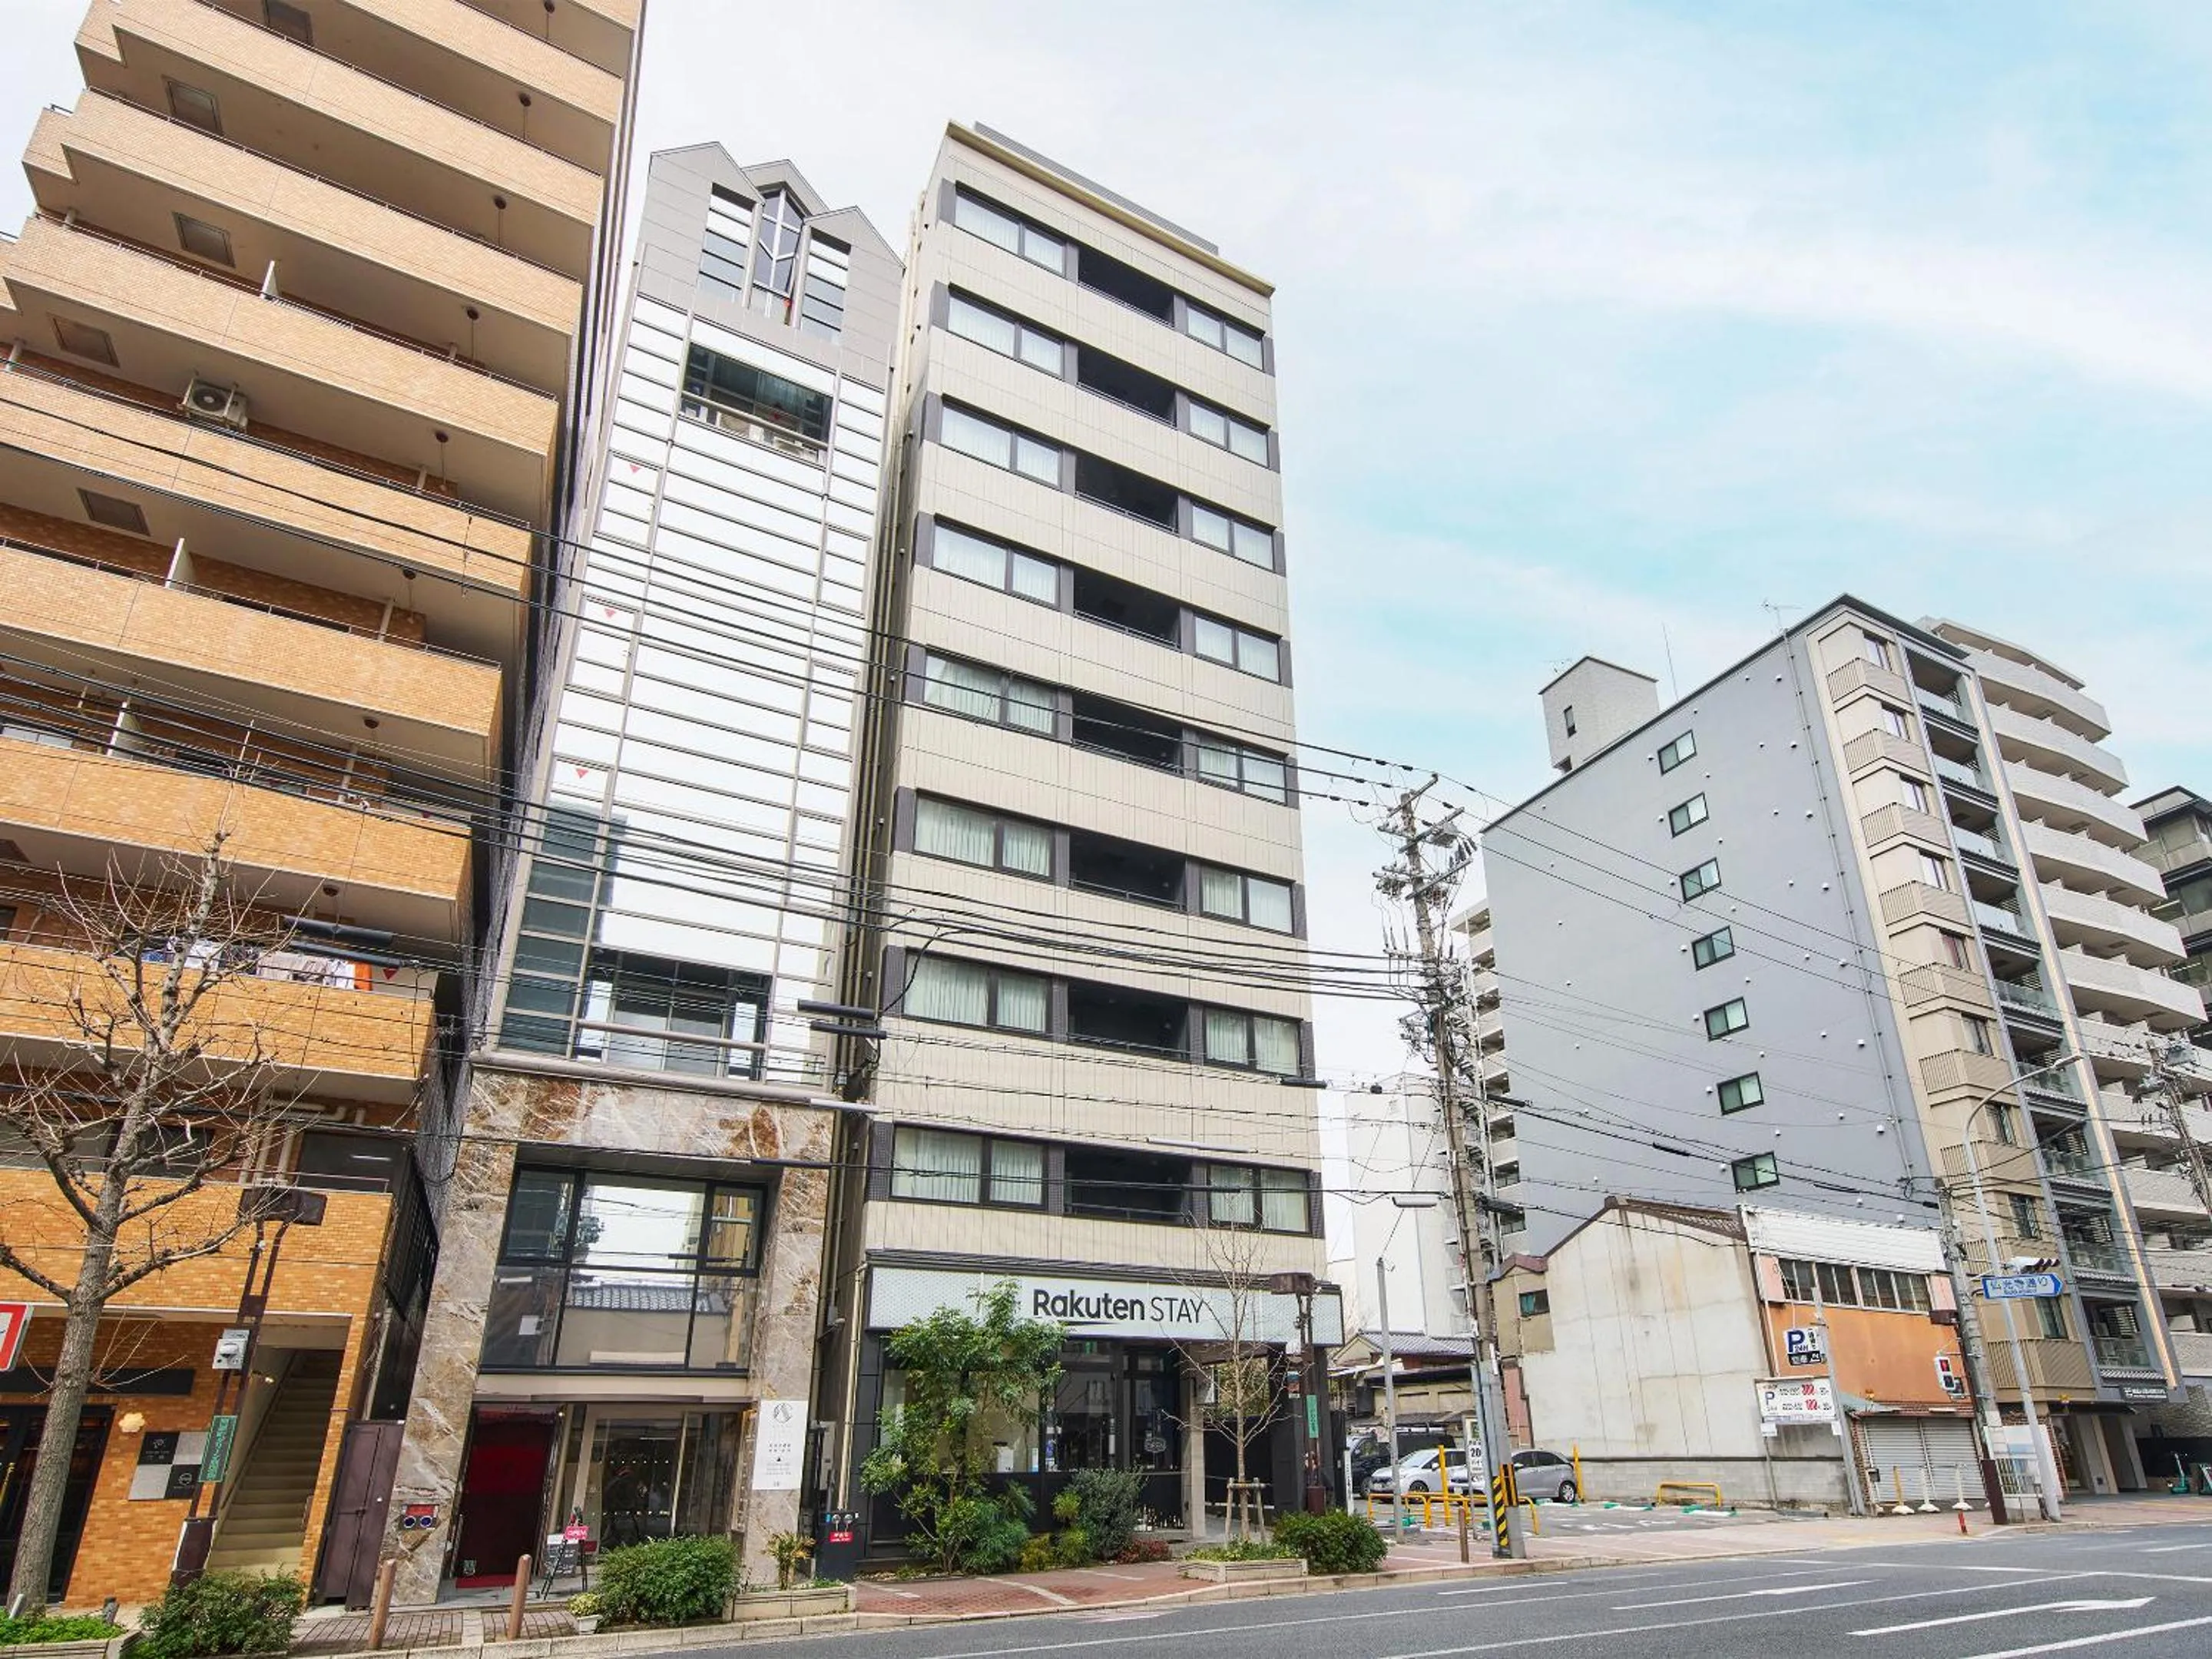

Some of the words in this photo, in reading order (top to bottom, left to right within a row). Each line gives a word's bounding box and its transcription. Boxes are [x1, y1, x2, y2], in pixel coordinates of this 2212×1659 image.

[1033, 1289, 1145, 1320] Rakuten
[1151, 1296, 1205, 1323] STAY
[1787, 1330, 1805, 1353] P
